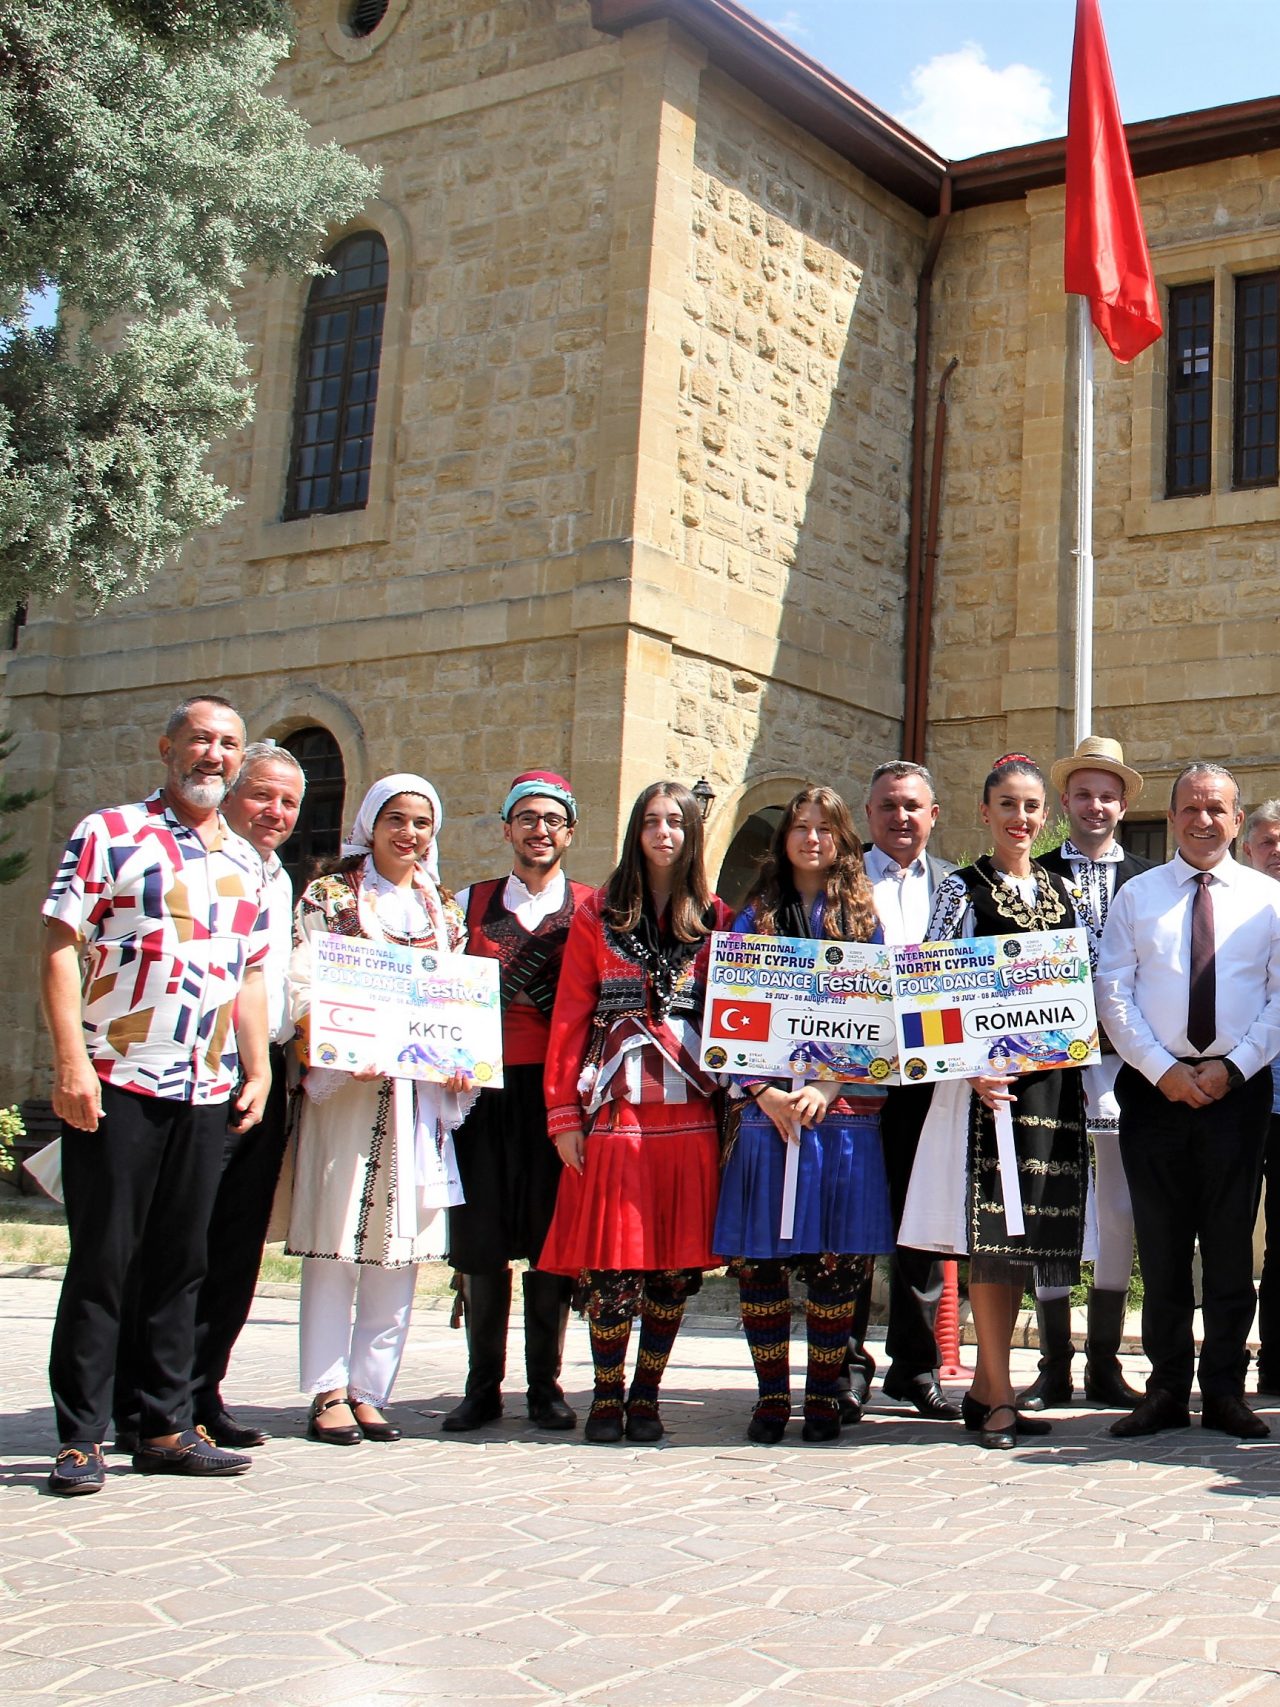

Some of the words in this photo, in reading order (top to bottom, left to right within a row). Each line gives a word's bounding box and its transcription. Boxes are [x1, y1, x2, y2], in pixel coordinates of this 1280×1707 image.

[318, 941, 394, 959] INTERNATIONAL
[717, 941, 796, 954] INTERNATIONAL
[895, 947, 974, 962] INTERNATIONAL
[318, 951, 361, 967] NORTH
[366, 959, 412, 974] CYPRUS
[715, 951, 760, 964] NORTH
[765, 955, 815, 968] CYPRUS
[896, 959, 941, 974] NORTH
[945, 955, 995, 969] CYPRUS
[319, 966, 356, 984] FOLK
[360, 974, 411, 994] DANCE
[417, 979, 491, 1007] Festival
[715, 968, 755, 984] FOLK
[759, 972, 811, 988] DANCE
[819, 973, 892, 996] Festiva
[899, 979, 938, 994] FOLK
[943, 972, 995, 990] DANCE
[1001, 960, 1080, 986] Festival
[788, 1016, 880, 1040] TÜRKİYE
[976, 1007, 1075, 1031] ROMANIA
[409, 1021, 462, 1041] KKTC
